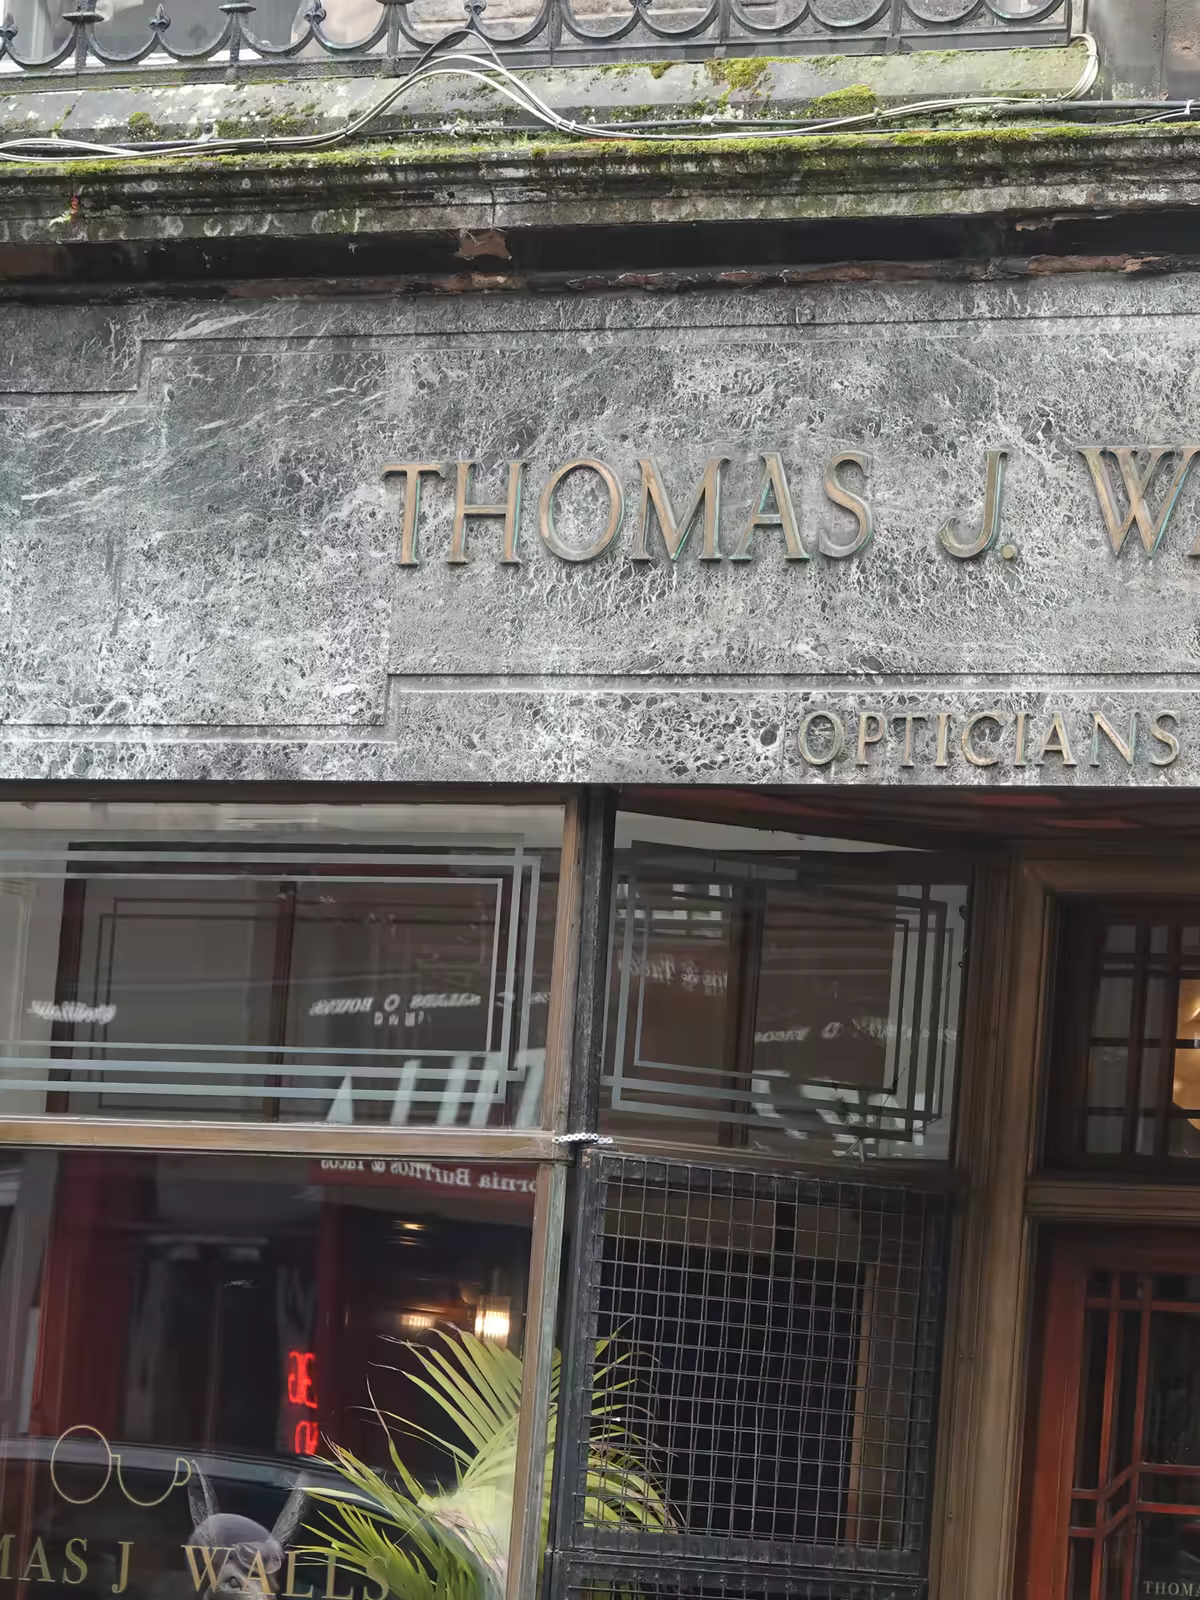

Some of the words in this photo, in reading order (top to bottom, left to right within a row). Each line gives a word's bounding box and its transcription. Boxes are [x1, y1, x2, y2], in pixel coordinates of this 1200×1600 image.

[383, 449, 874, 567] THOMAS
[937, 445, 1018, 560] J.
[799, 709, 1181, 769] OPTICIANS
[111, 1542, 135, 1594] J
[181, 1544, 391, 1600] WALLS
